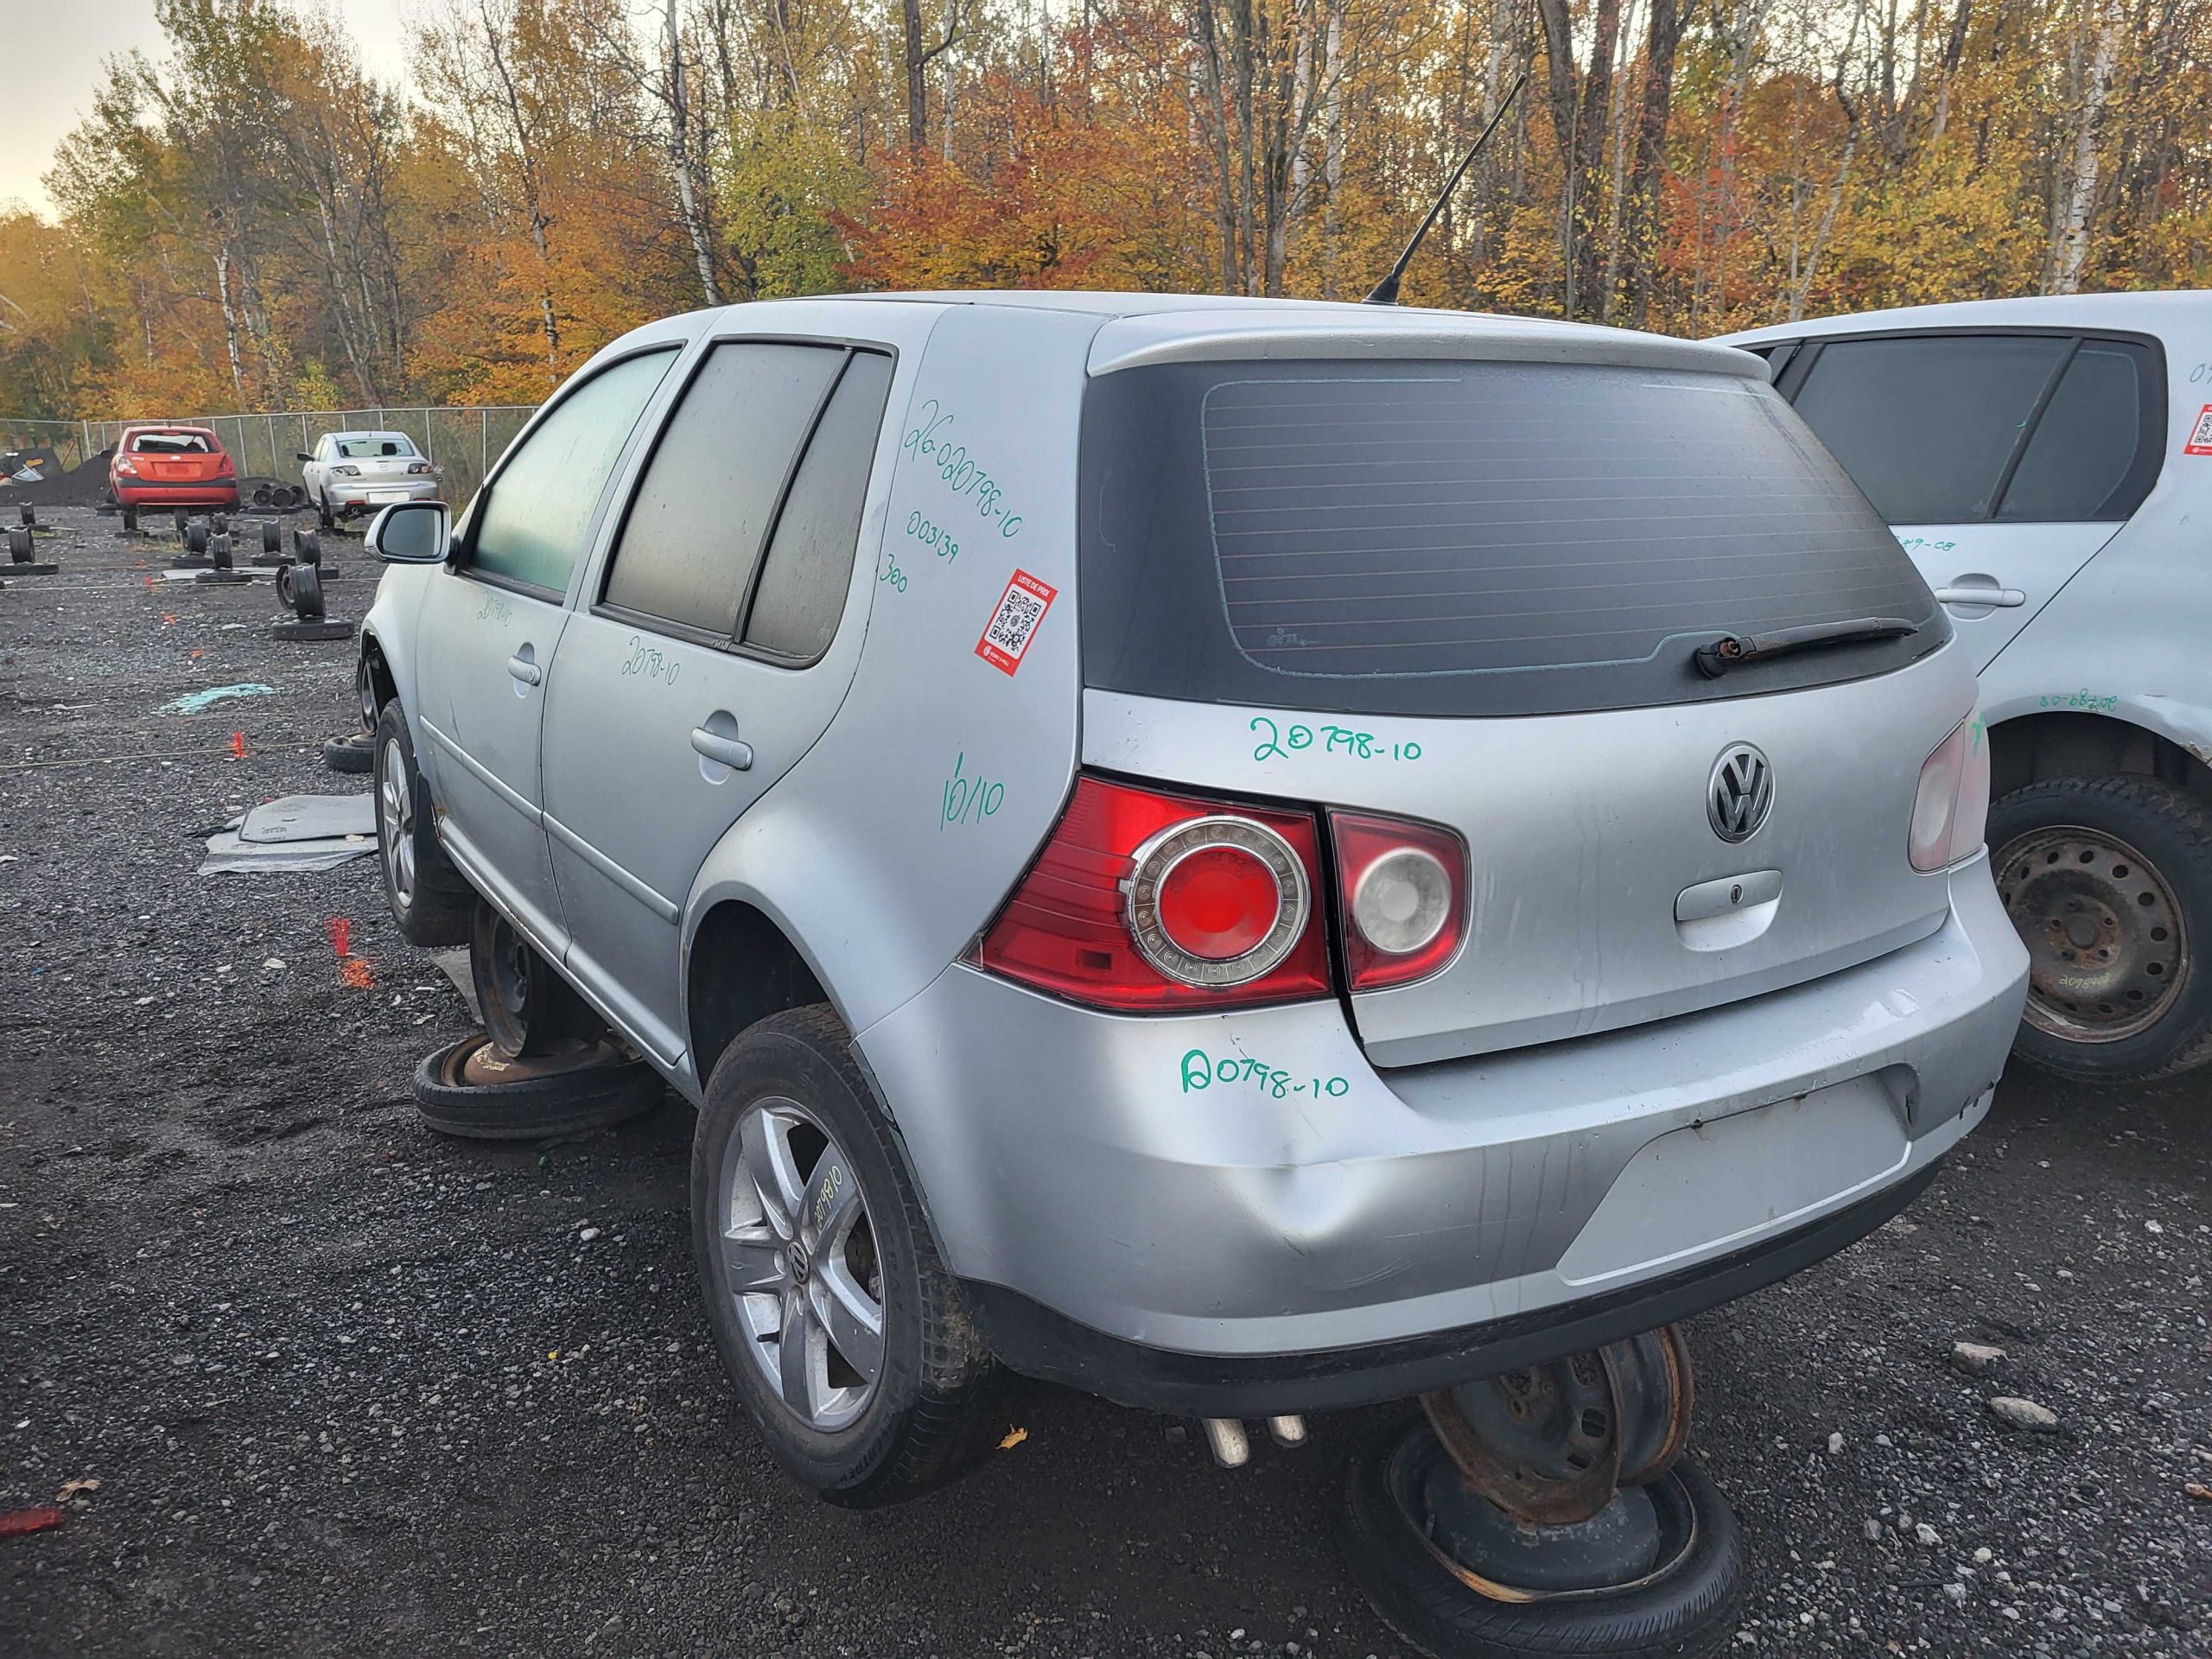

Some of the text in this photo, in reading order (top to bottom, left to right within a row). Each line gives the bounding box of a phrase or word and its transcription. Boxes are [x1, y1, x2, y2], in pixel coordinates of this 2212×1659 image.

[880, 553, 907, 593] 300
[1017, 575, 1032, 588] LISTE
[1037, 585, 1051, 597] PRIX
[621, 636, 680, 685] 20798-10
[1250, 717, 1422, 761] 20798-10
[1707, 741, 1775, 846] VW
